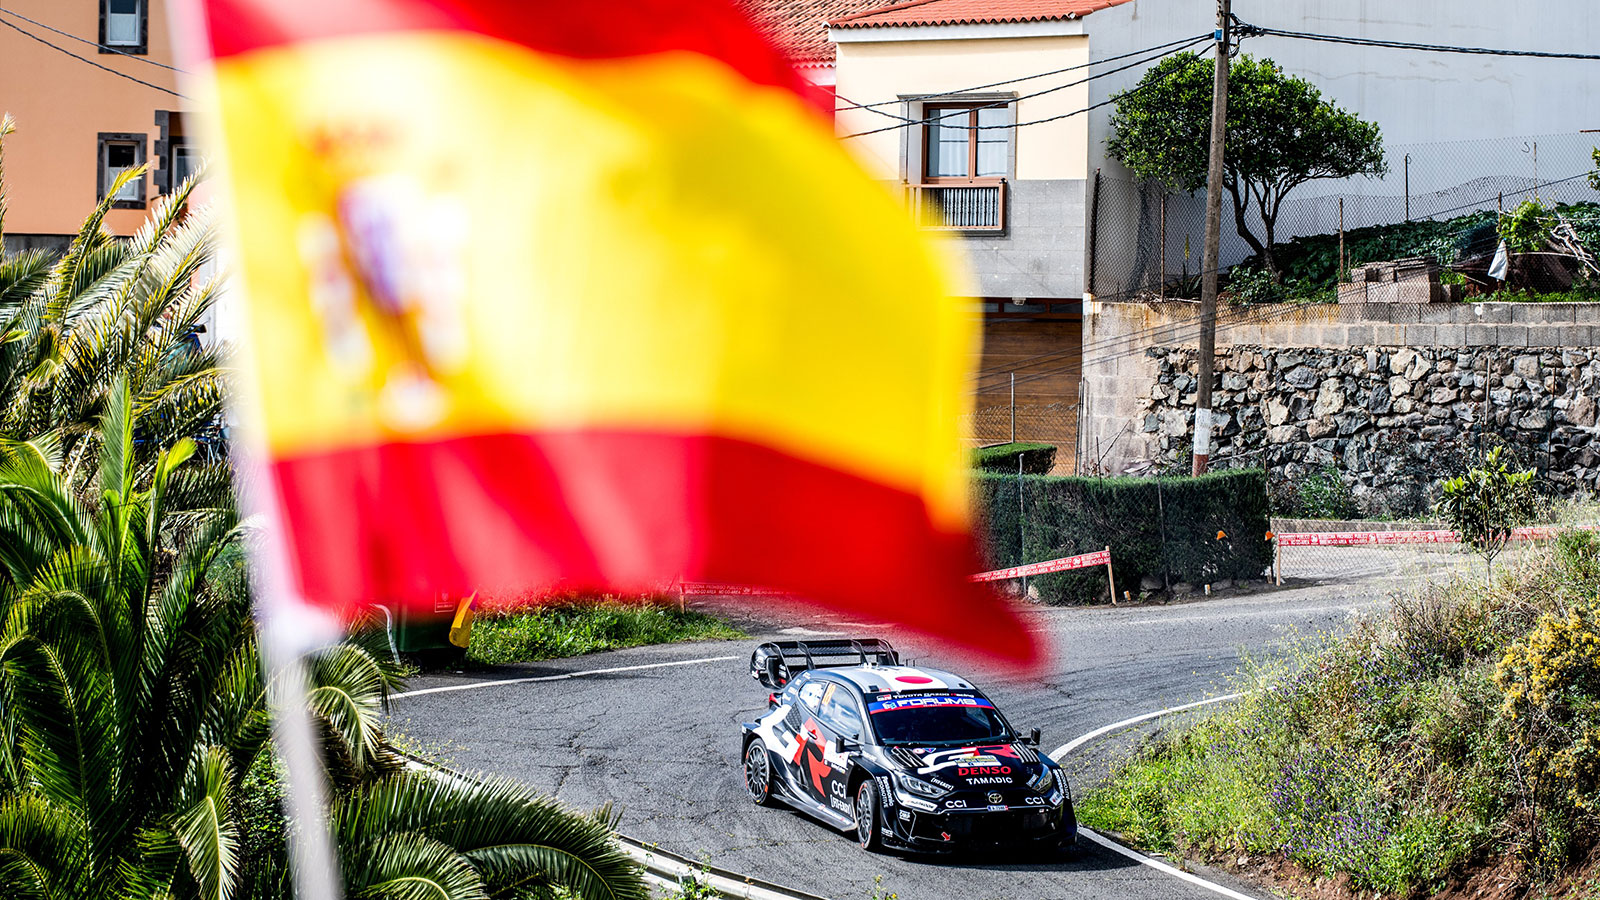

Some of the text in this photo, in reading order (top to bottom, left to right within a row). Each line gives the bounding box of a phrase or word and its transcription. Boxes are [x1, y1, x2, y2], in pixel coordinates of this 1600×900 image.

[958, 765, 1012, 777] DENSO
[966, 776, 1013, 785] TAMADIC
[945, 799, 968, 809] CCI
[1024, 796, 1046, 805] CCI
